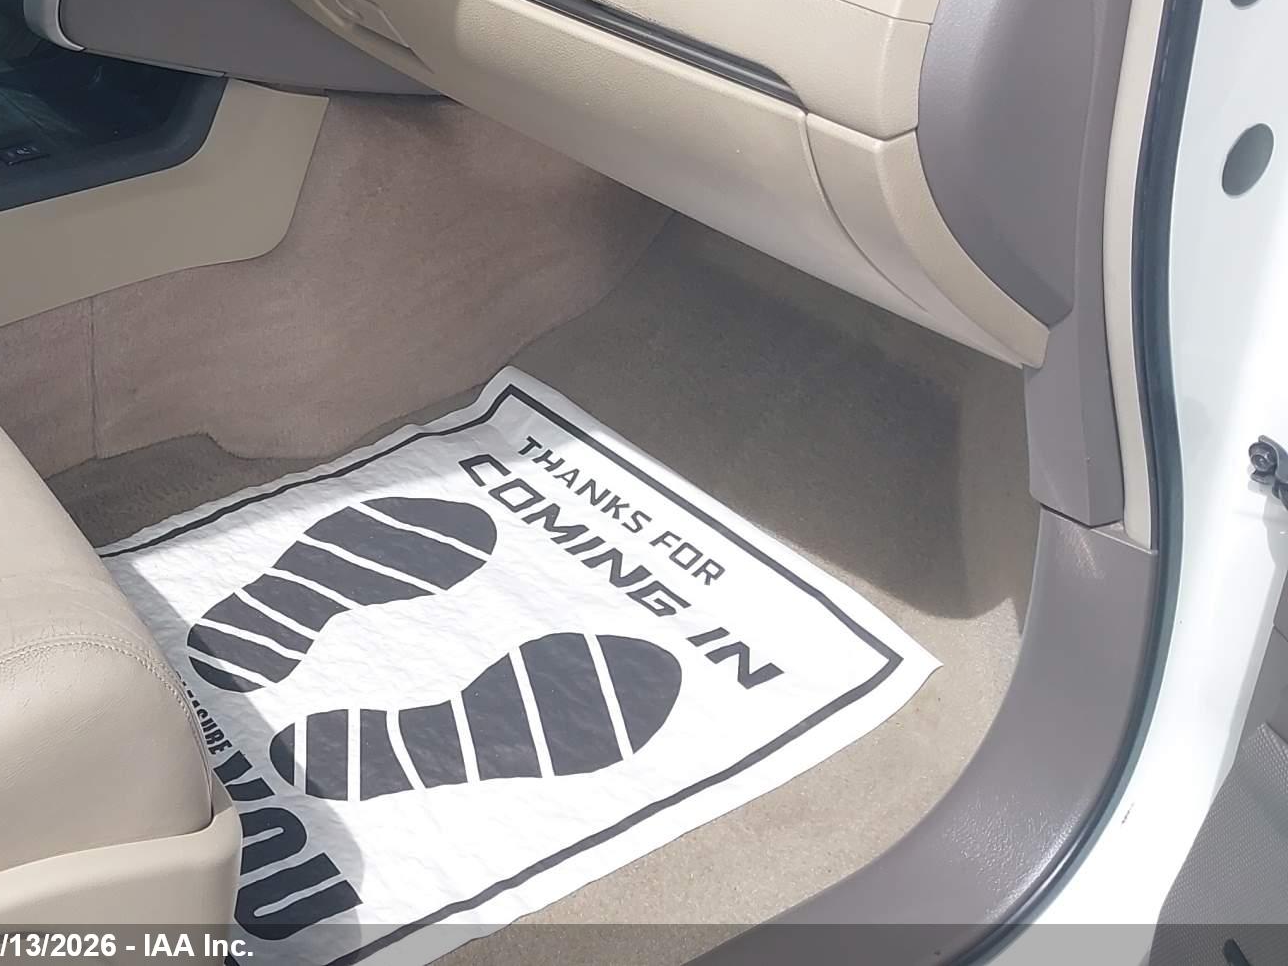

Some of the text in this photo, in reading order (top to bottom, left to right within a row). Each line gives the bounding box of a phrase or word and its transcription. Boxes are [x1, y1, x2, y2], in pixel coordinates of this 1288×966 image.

[458, 454, 784, 689] COMING IN
[518, 436, 725, 585] THANKS FOR
